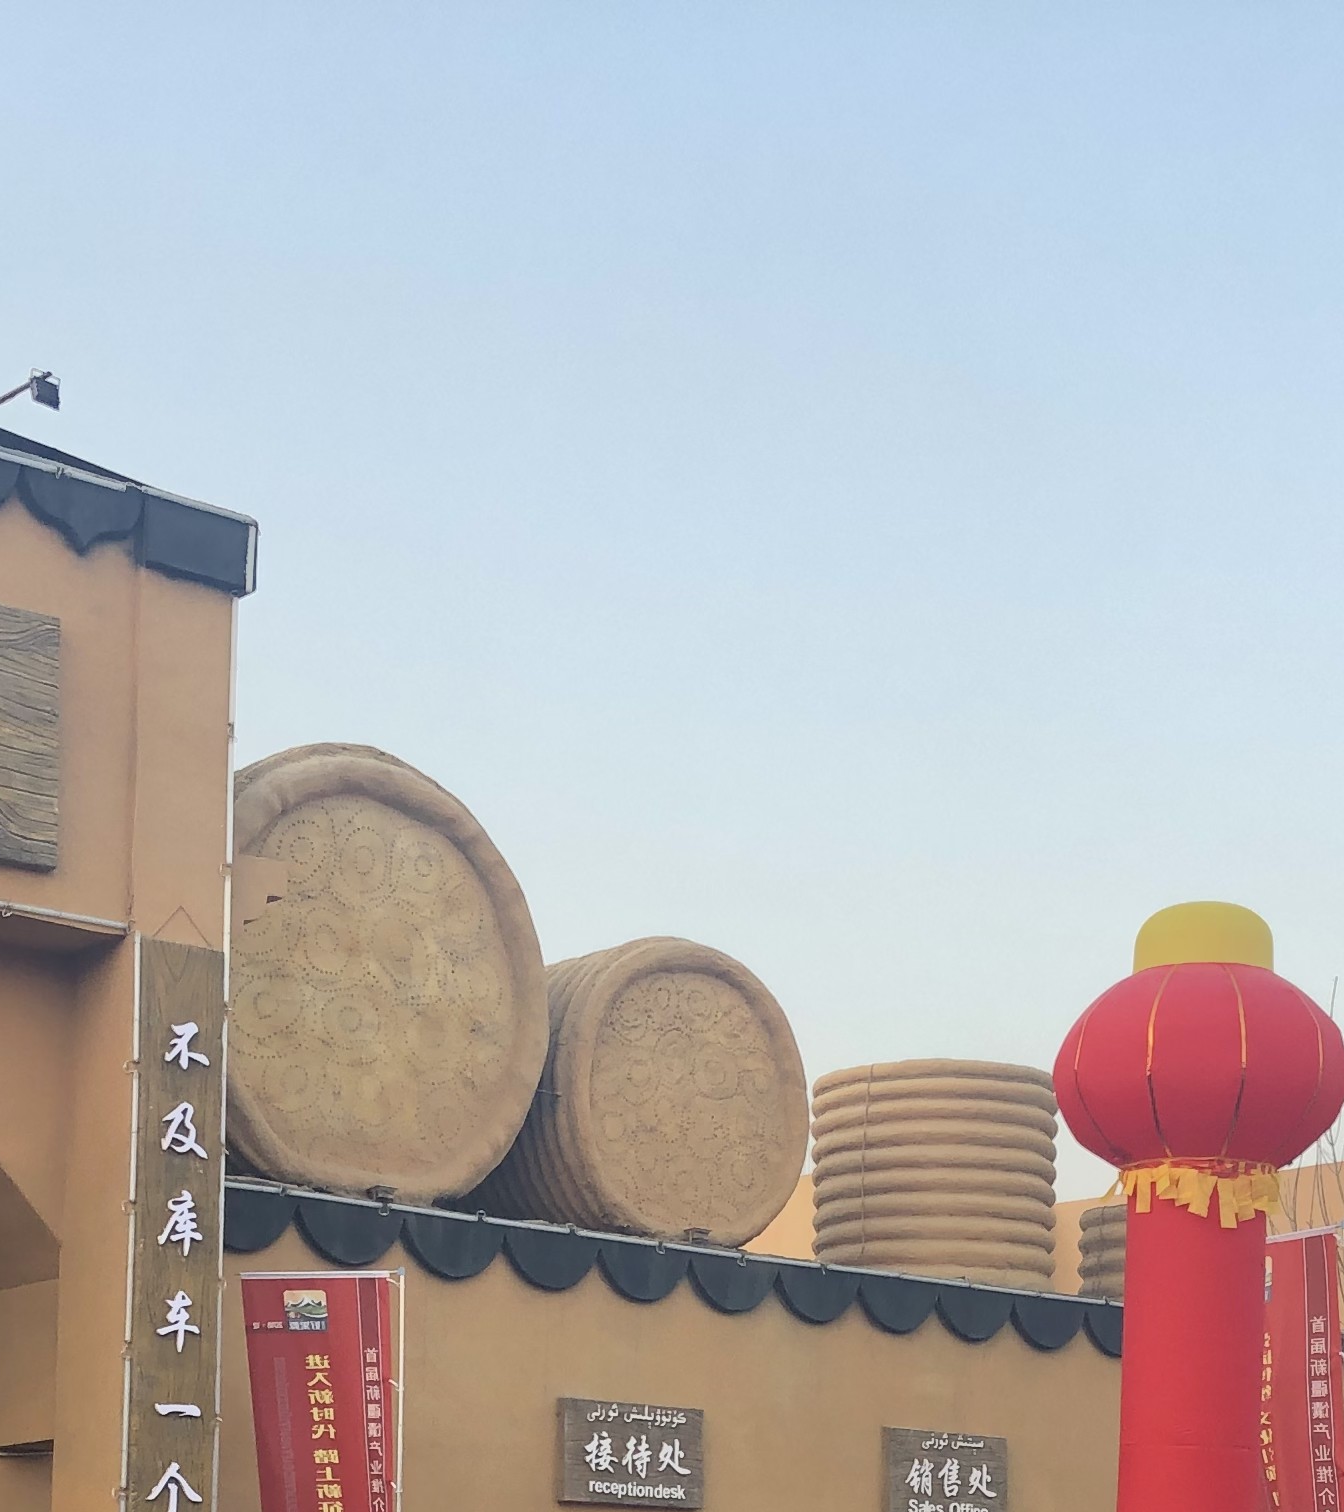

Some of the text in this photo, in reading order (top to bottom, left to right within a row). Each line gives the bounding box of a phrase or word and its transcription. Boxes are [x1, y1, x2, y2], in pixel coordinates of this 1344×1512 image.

[584, 1431, 692, 1480] 接待处
[588, 1477, 687, 1501] receptiondesk
[904, 1457, 998, 1499] 销售处
